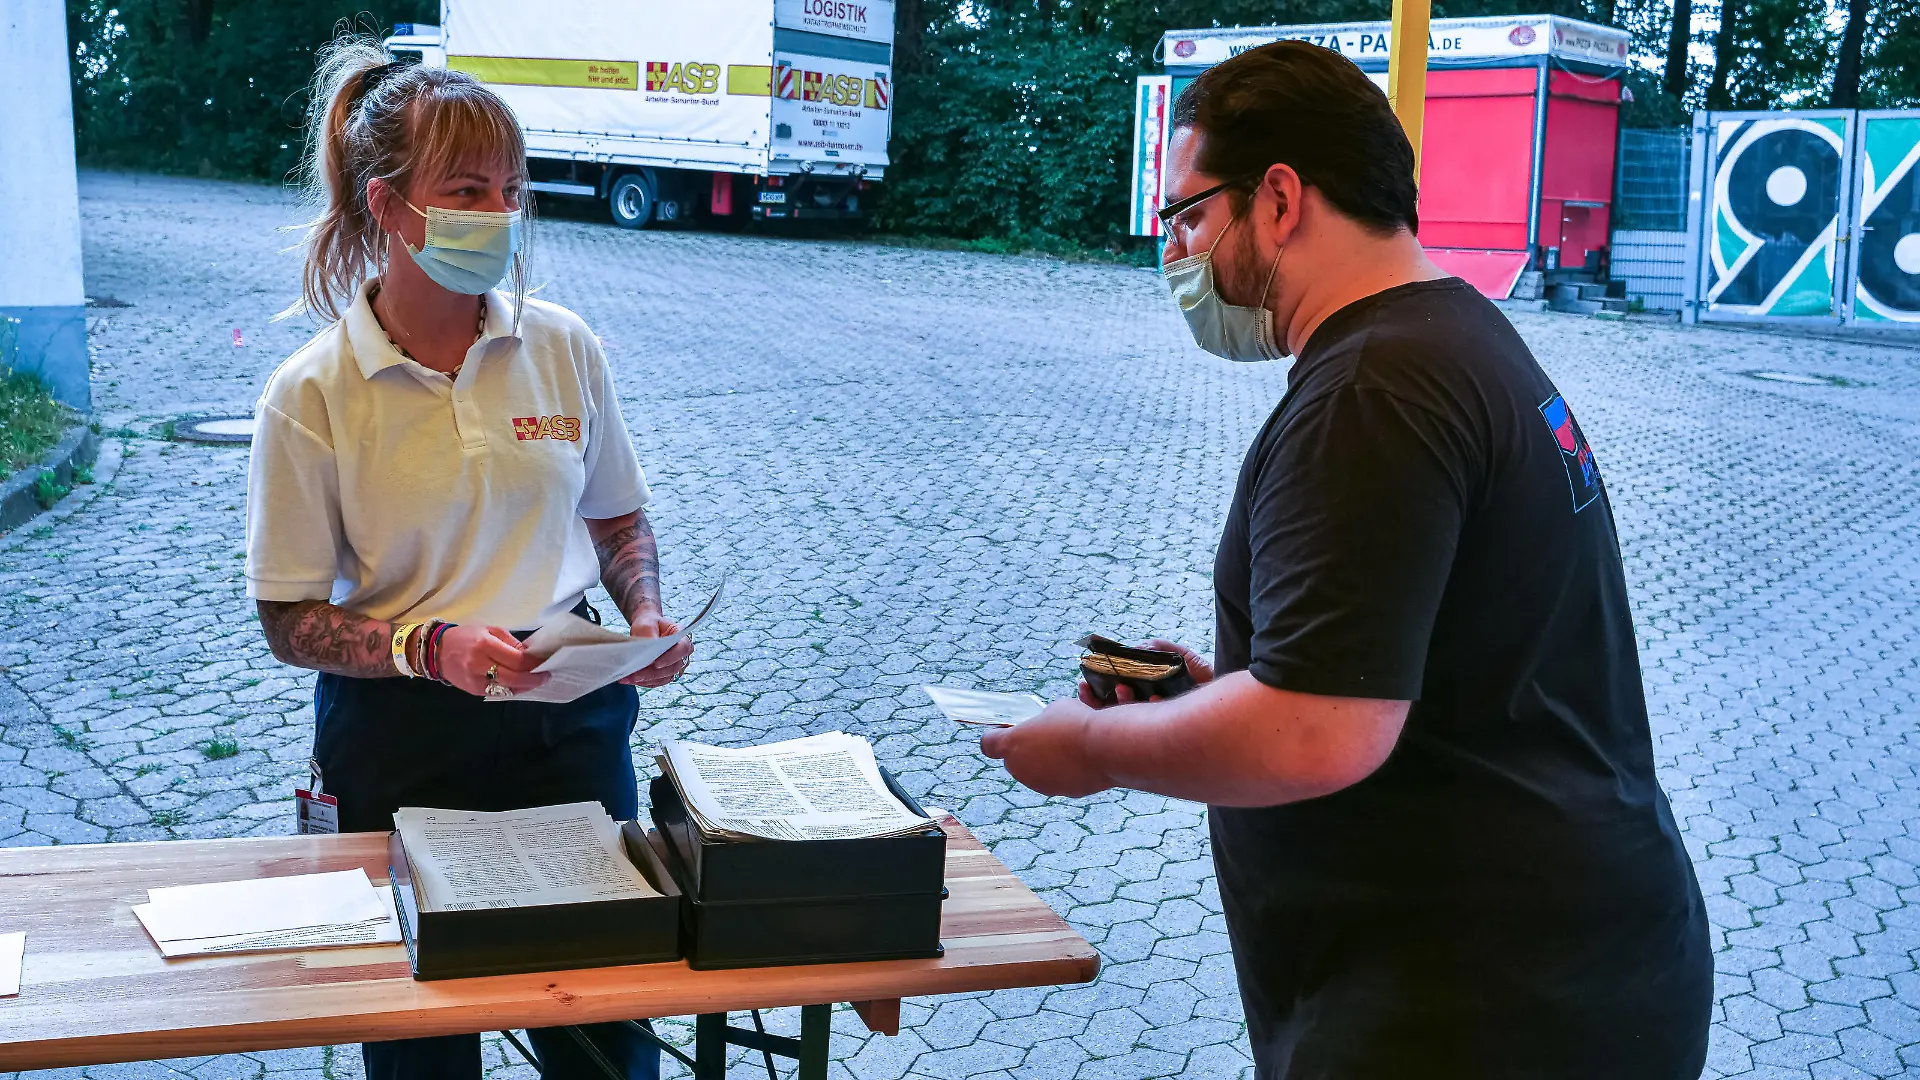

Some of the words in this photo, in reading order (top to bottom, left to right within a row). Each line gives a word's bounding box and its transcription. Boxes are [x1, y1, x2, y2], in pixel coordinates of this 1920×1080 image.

[804, 0, 867, 23] LOGISTIK
[662, 62, 721, 94] ASB
[818, 74, 863, 106] ASB
[536, 415, 581, 442] ASB
